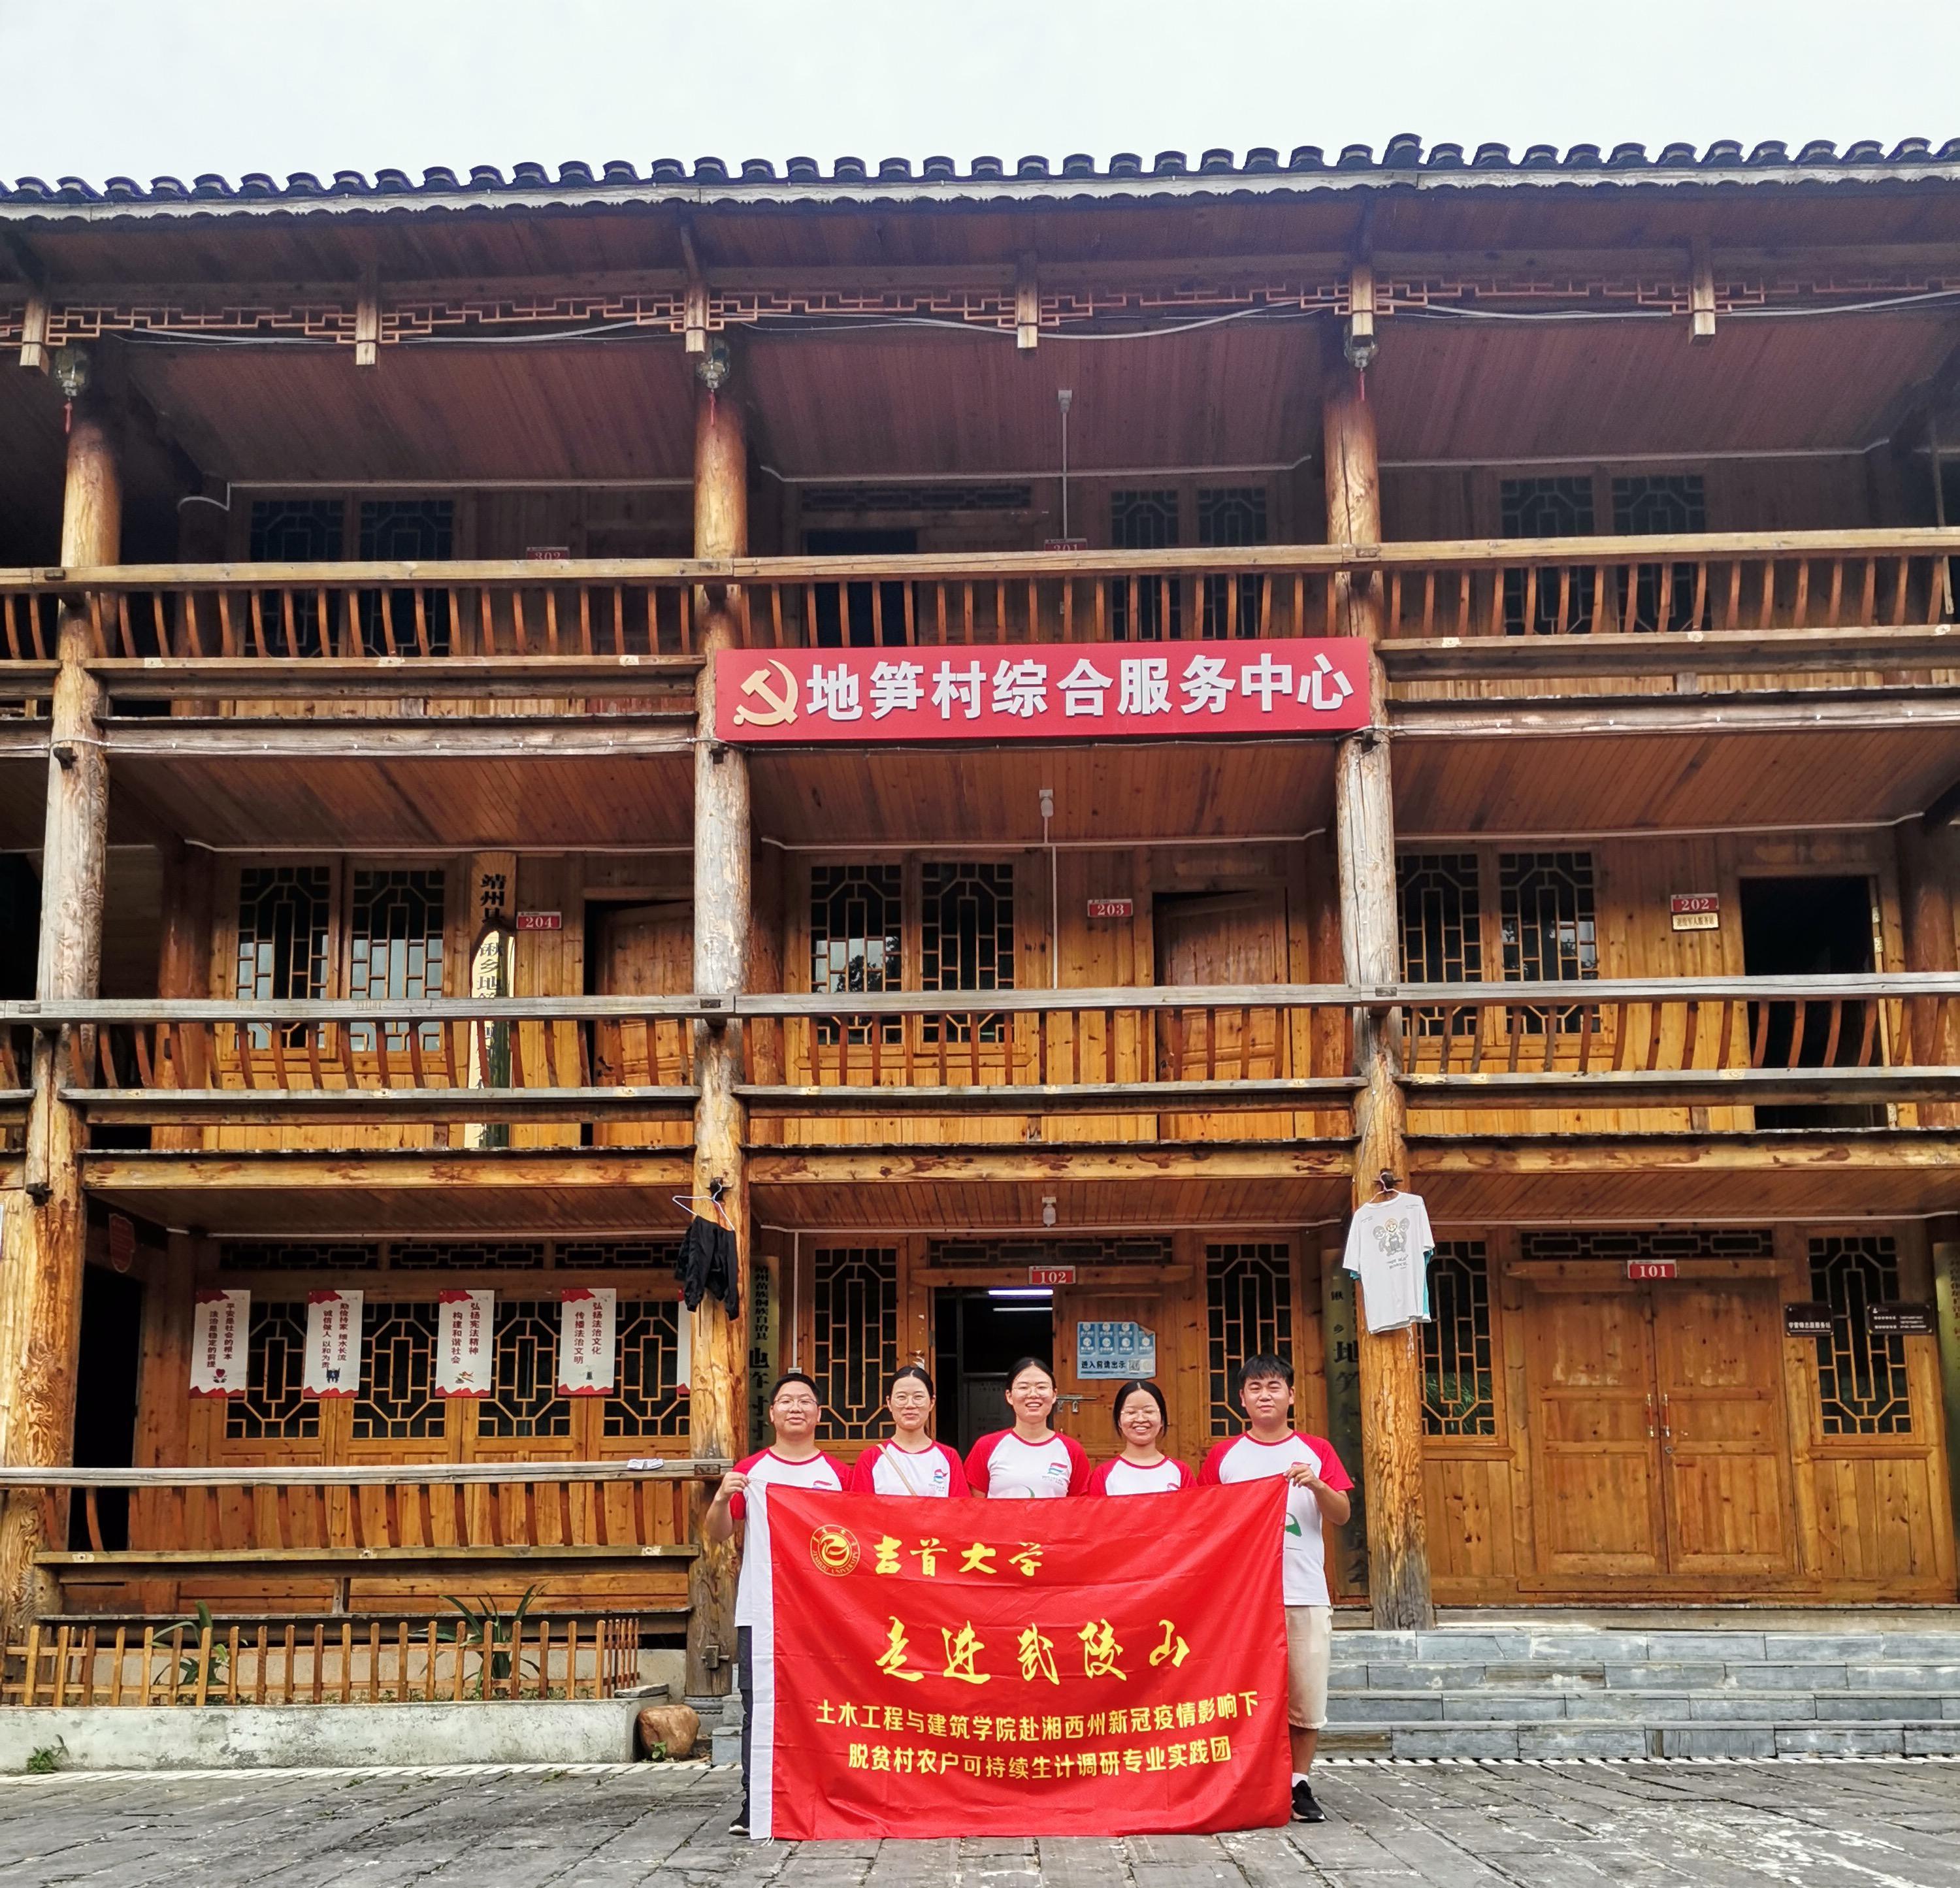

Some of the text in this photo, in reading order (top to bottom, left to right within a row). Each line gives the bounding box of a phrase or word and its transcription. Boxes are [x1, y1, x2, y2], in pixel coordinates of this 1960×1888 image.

[806, 653, 1354, 722] 地笋村综合服务中心
[526, 916, 553, 929] 204
[1098, 903, 1124, 915] 203
[1681, 898, 1710, 911] 202
[1040, 1271, 1067, 1284] 102
[1640, 1265, 1667, 1278] 101
[207, 1310, 219, 1367] 法治是稳定的前提
[223, 1303, 235, 1360] 平安是社会的根本
[321, 1310, 333, 1369] 诚信做人 以和为贵
[337, 1303, 350, 1361] 勤俭持家 细水长流
[451, 1311, 463, 1364] 构建和谐社会
[469, 1302, 481, 1355] 弘扬宪法精神
[574, 1311, 585, 1365] 传播法治文明
[591, 1302, 602, 1355] 弘扬法治文化
[1081, 1360, 1126, 1370] 进入前请出示
[874, 1537, 1045, 1576] 吉首大学
[875, 1616, 1192, 1685] 走进武陵山
[815, 1690, 1260, 1742] 土木工程与建筑学院赴湘西州新冠疫情影响下
[848, 1736, 1233, 1780] 脱贫村农户可持续生计调研专业实践团
